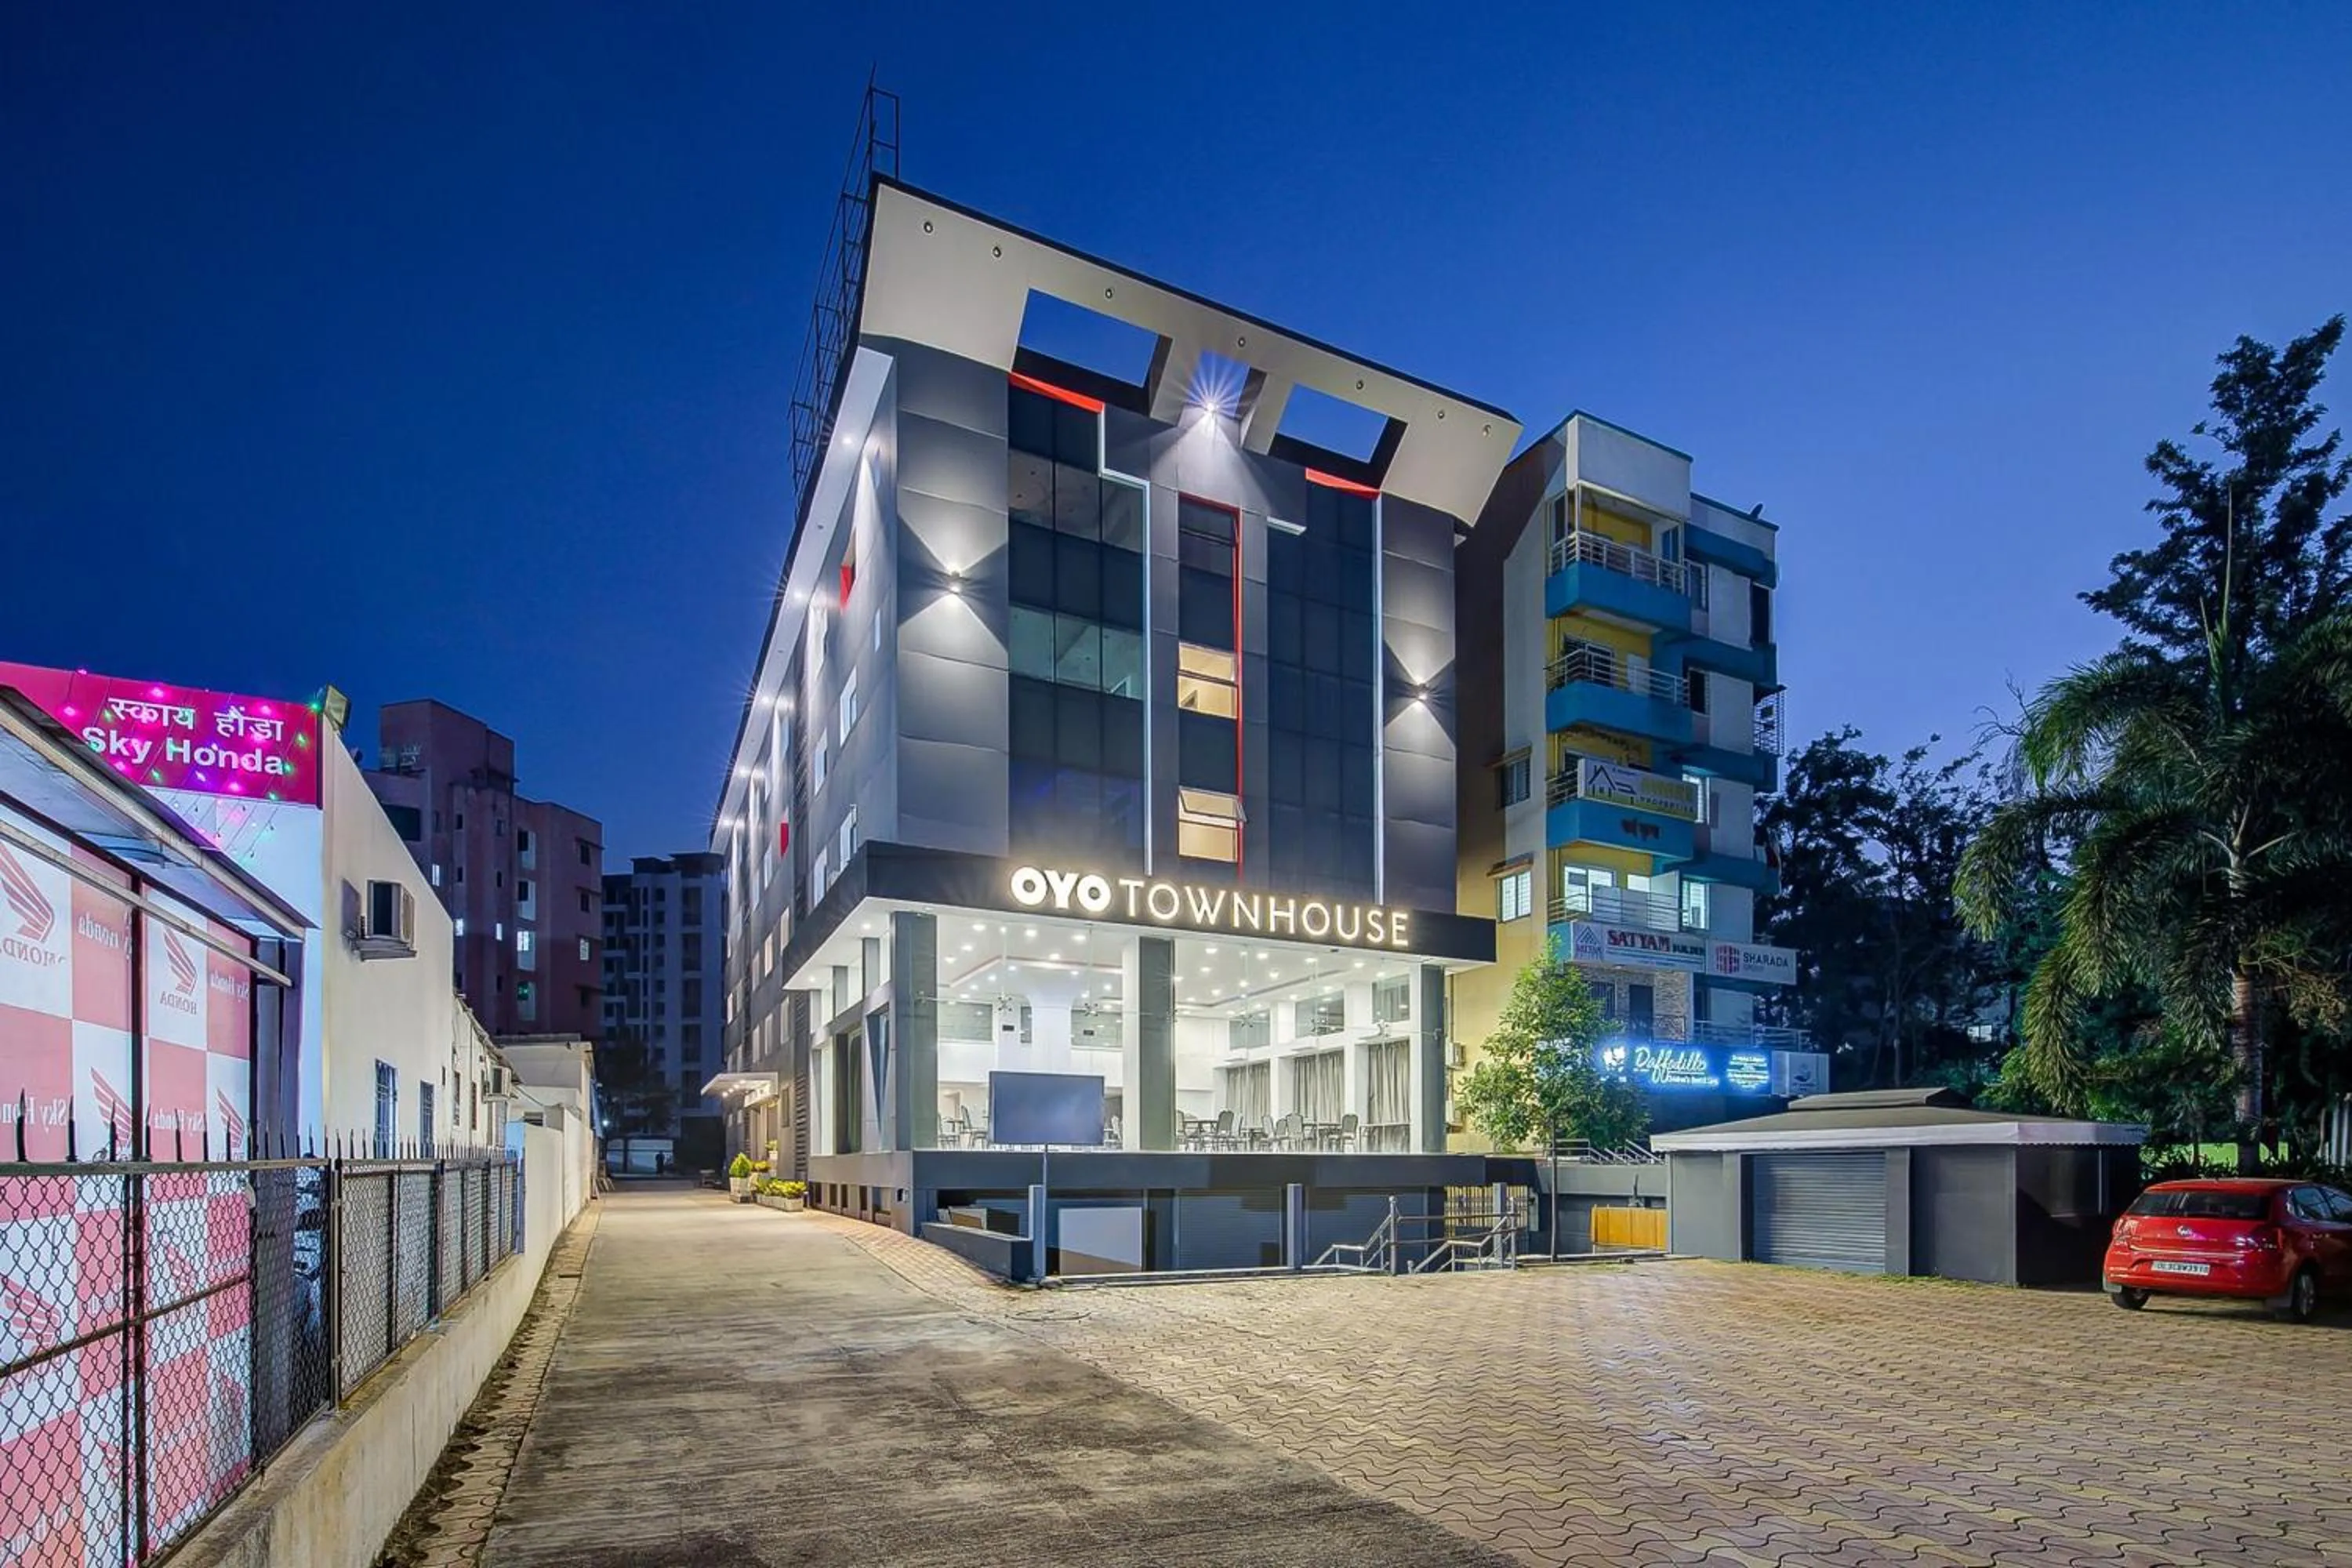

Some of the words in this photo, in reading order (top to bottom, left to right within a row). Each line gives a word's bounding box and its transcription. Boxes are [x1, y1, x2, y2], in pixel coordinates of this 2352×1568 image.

[107, 697, 196, 730] स्काय
[82, 726, 152, 764] Sky
[165, 736, 285, 775] Honda
[1011, 866, 1111, 912] OYO
[1119, 878, 1409, 946] TOWNHOUSE
[1607, 929, 1671, 953] SATYAM
[1743, 951, 1788, 967] SHARADA
